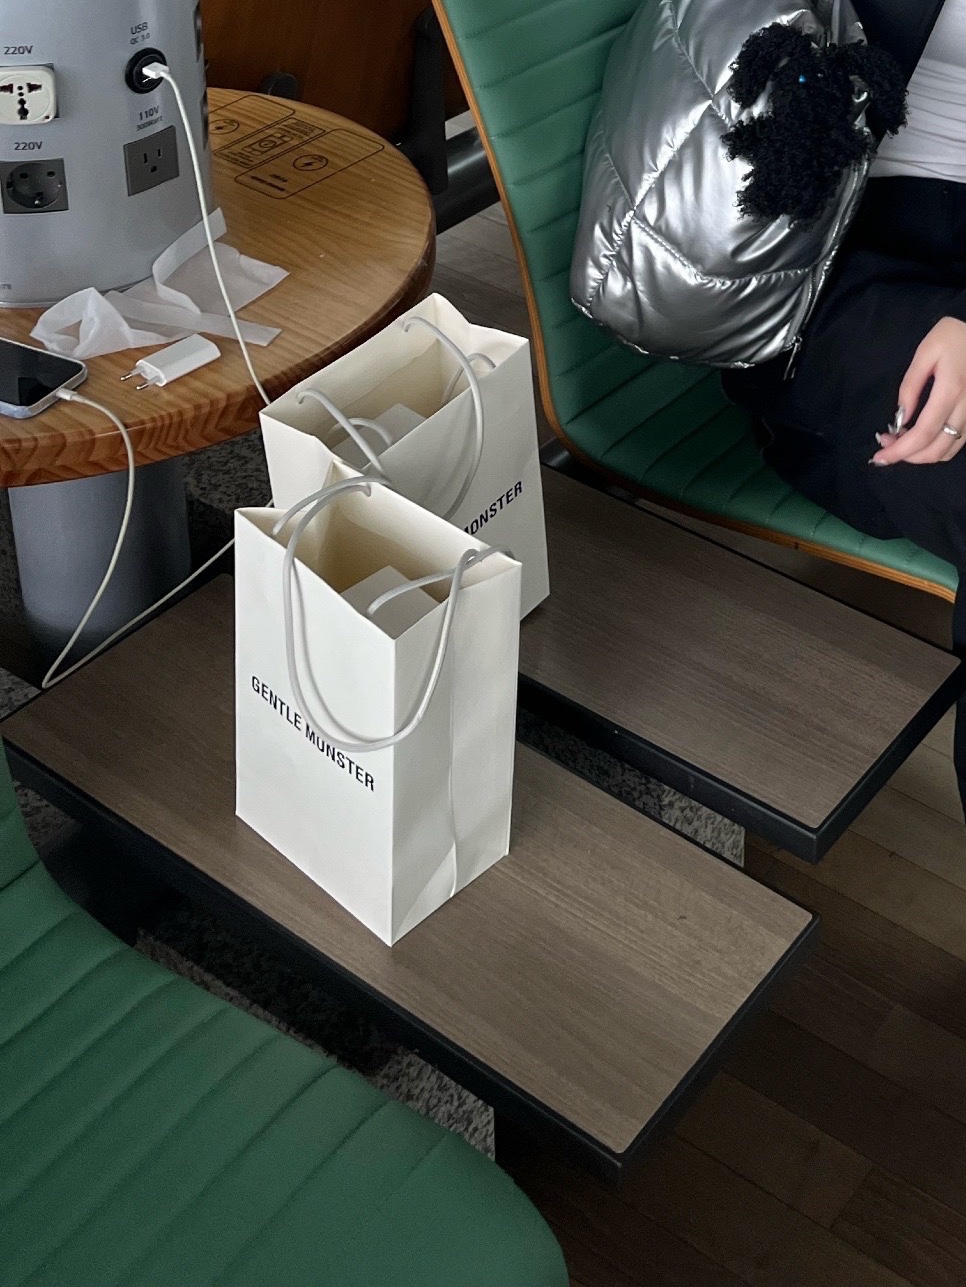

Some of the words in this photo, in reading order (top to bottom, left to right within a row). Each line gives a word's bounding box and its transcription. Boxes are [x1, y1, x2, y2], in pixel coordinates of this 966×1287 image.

[130, 21, 149, 35] USB
[3, 45, 33, 55] 220V
[138, 104, 160, 121] 110V
[14, 141, 43, 151] 220V
[251, 675, 302, 732] GENTLE
